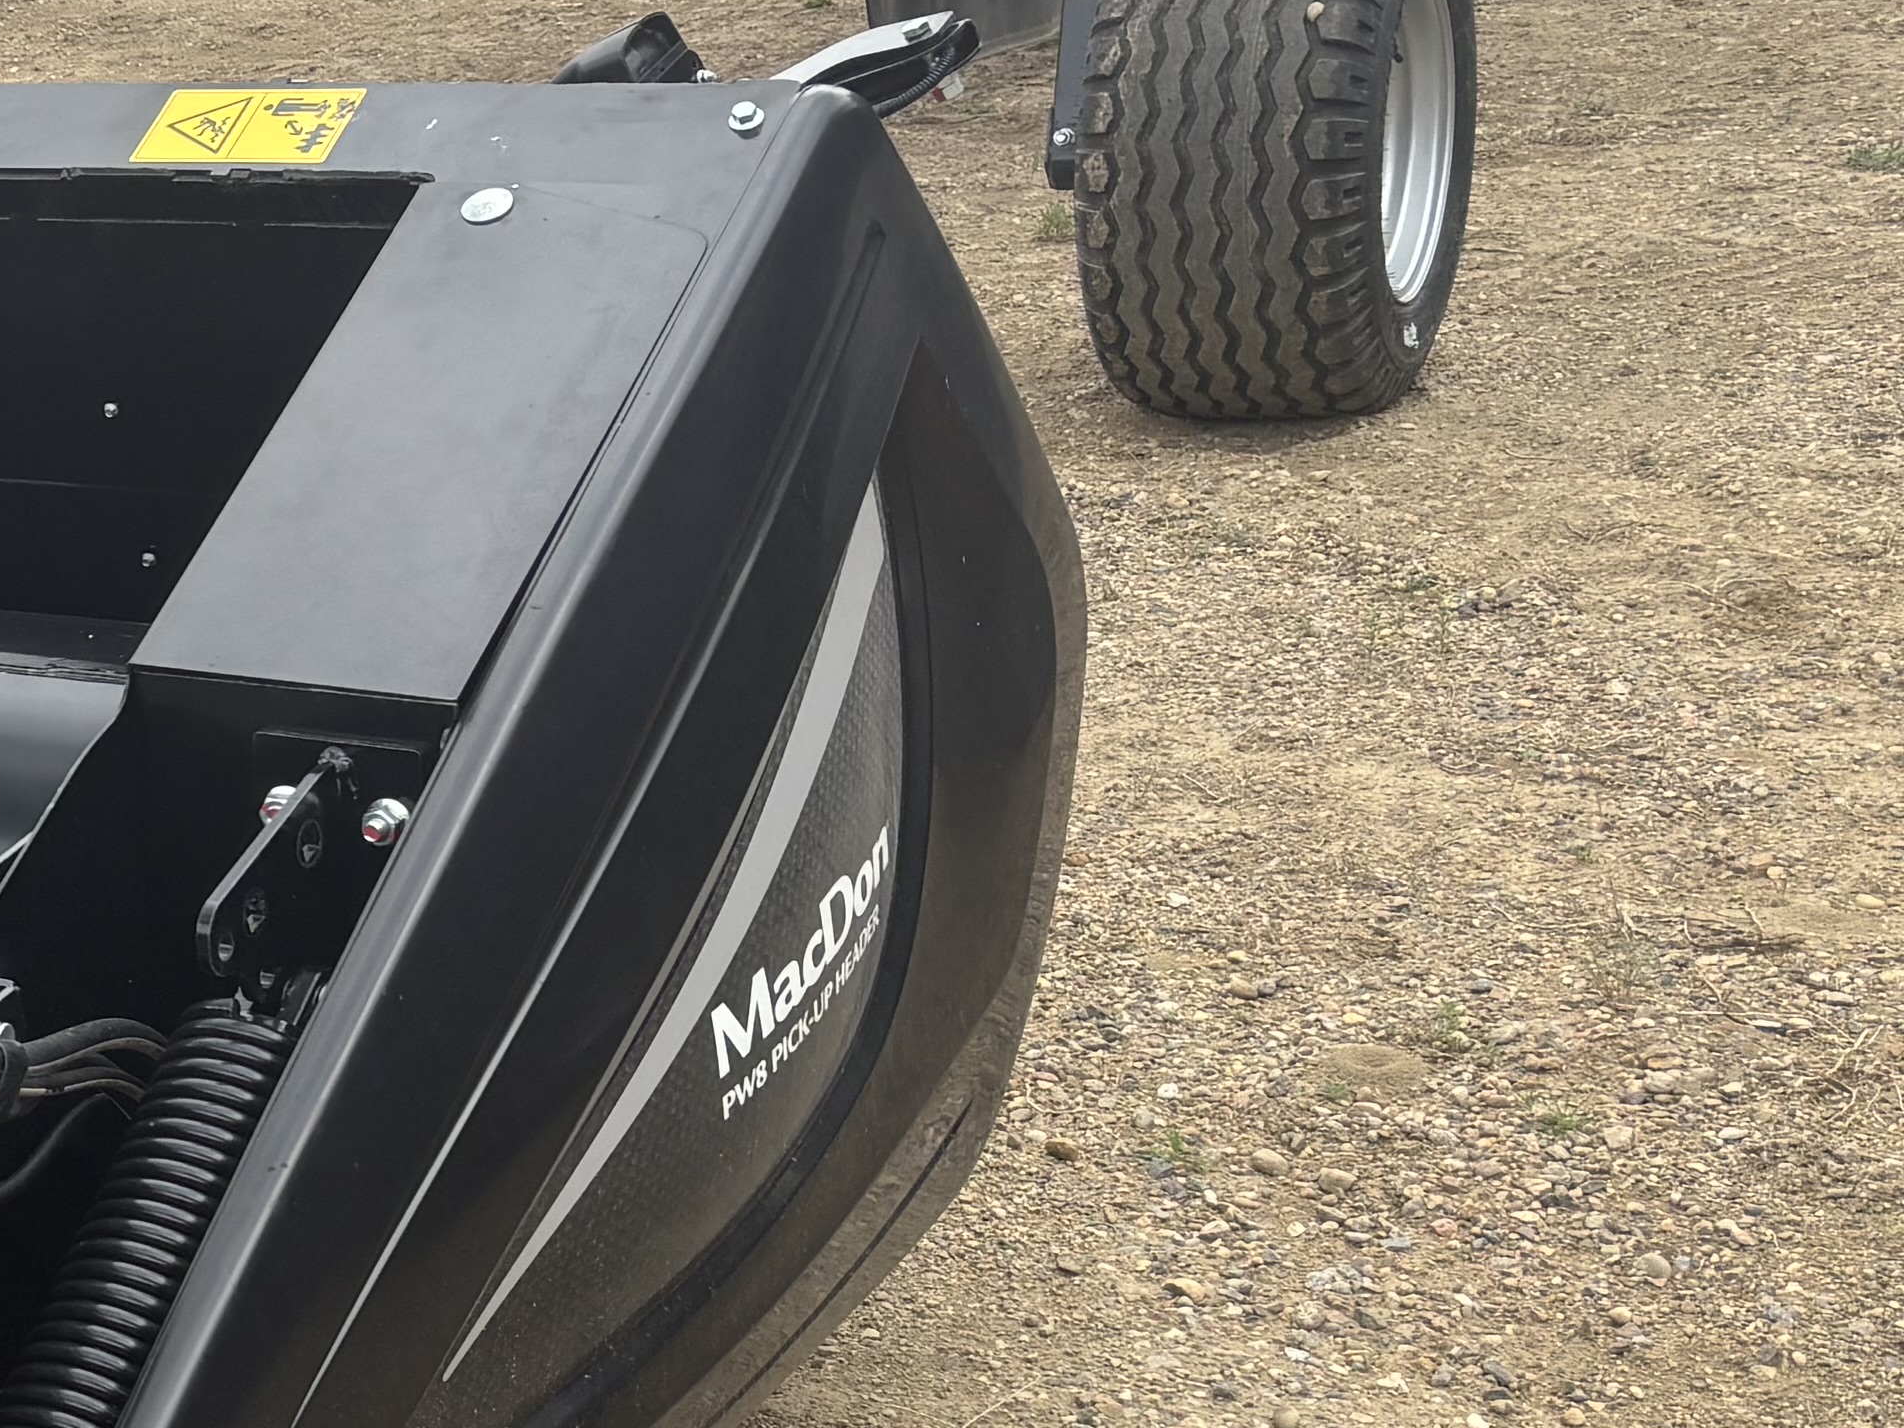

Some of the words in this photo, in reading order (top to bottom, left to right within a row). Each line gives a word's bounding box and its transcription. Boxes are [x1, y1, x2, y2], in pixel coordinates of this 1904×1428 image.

[711, 825, 890, 1079] MacDon
[722, 1059, 768, 1120] PW8
[771, 985, 833, 1073] PICK-UP
[835, 904, 881, 995] HEADER
